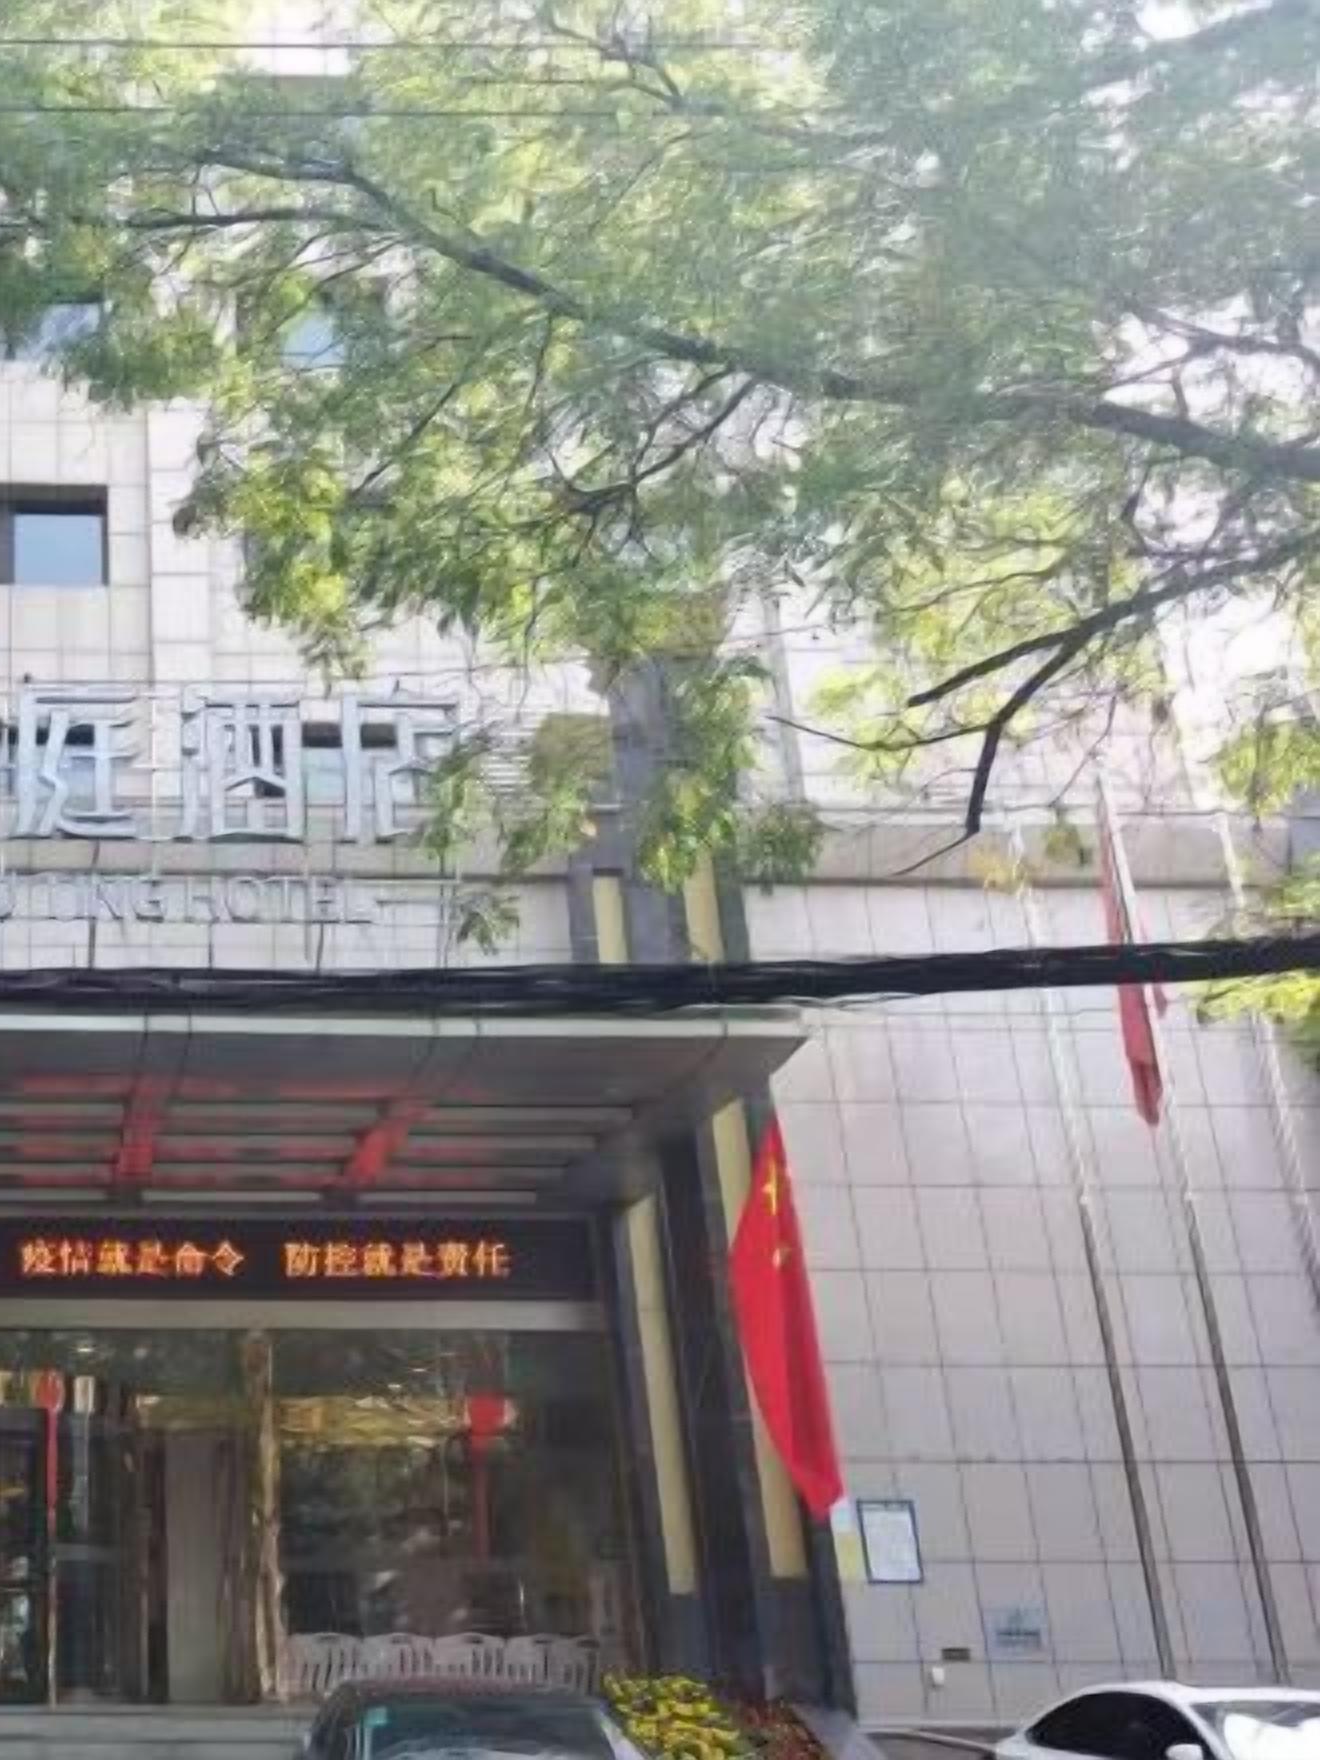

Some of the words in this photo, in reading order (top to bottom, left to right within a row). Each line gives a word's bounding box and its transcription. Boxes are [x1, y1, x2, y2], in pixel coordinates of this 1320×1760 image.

[183, 875, 373, 924] HOTEL
[20, 1238, 246, 1276] 疫情就是命令
